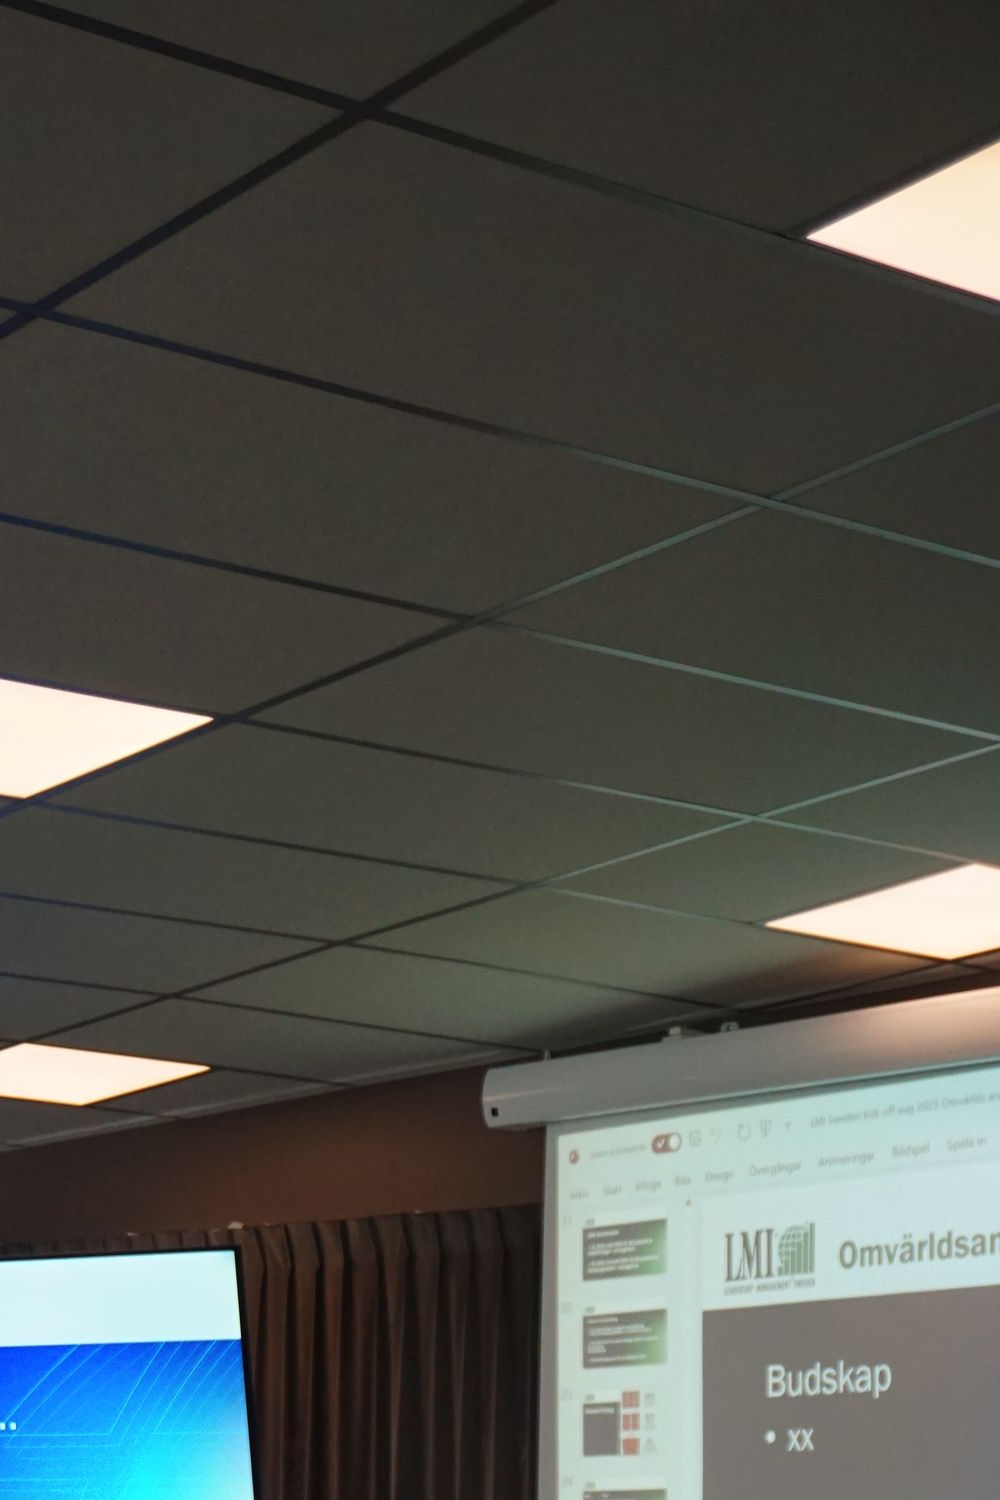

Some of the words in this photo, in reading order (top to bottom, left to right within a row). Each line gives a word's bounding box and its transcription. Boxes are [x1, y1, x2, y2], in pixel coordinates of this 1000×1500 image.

[705, 1169, 734, 1184] Design
[749, 1160, 801, 1177] Övergångar
[818, 1151, 874, 1167] Animeringar
[892, 1142, 930, 1158] Bildspel
[724, 1228, 774, 1282] LMI
[766, 1360, 892, 1399] Budskap
